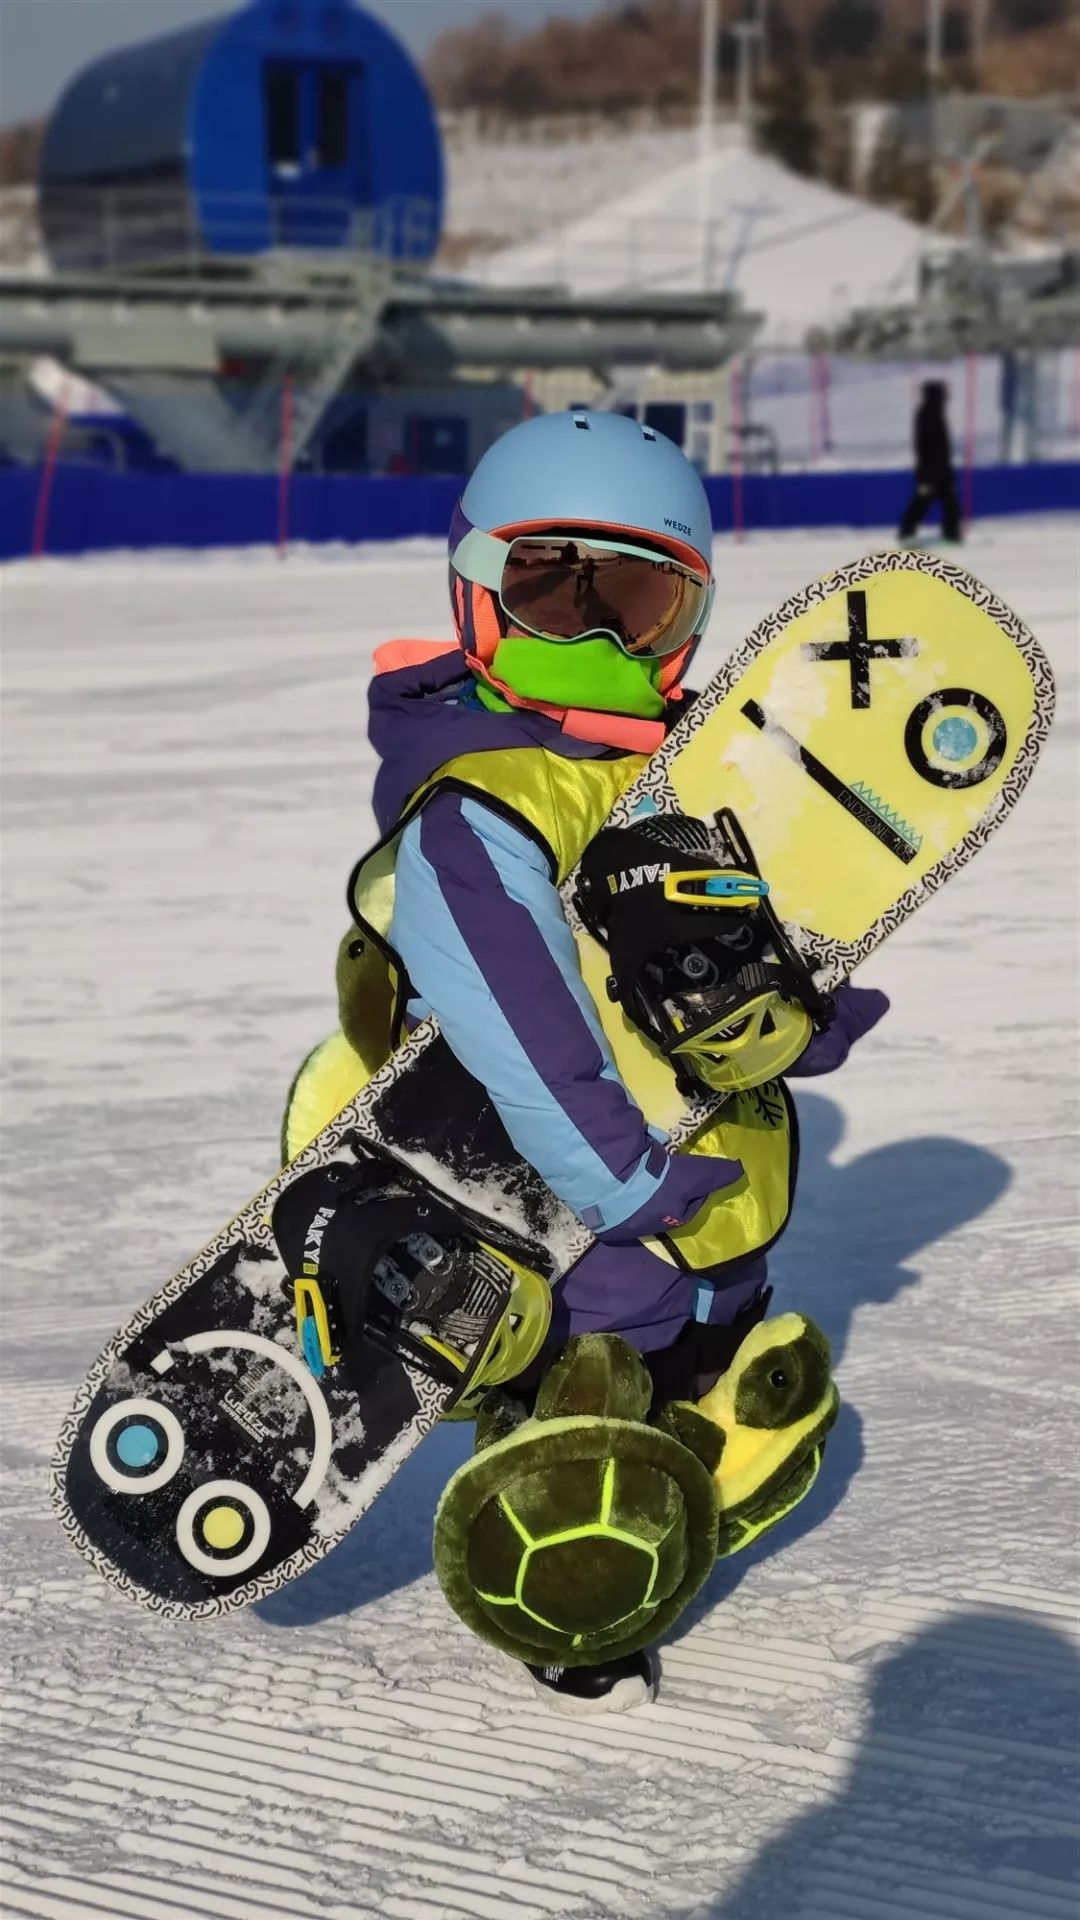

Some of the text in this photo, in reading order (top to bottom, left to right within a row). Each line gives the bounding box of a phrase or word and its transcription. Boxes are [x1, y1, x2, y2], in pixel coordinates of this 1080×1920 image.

[663, 516, 692, 537] WEDZE
[837, 789, 889, 842] ENDZONE
[619, 862, 671, 893] FAKY
[303, 1206, 336, 1265] FAKY
[217, 1399, 264, 1444] SNOWBOARDING
